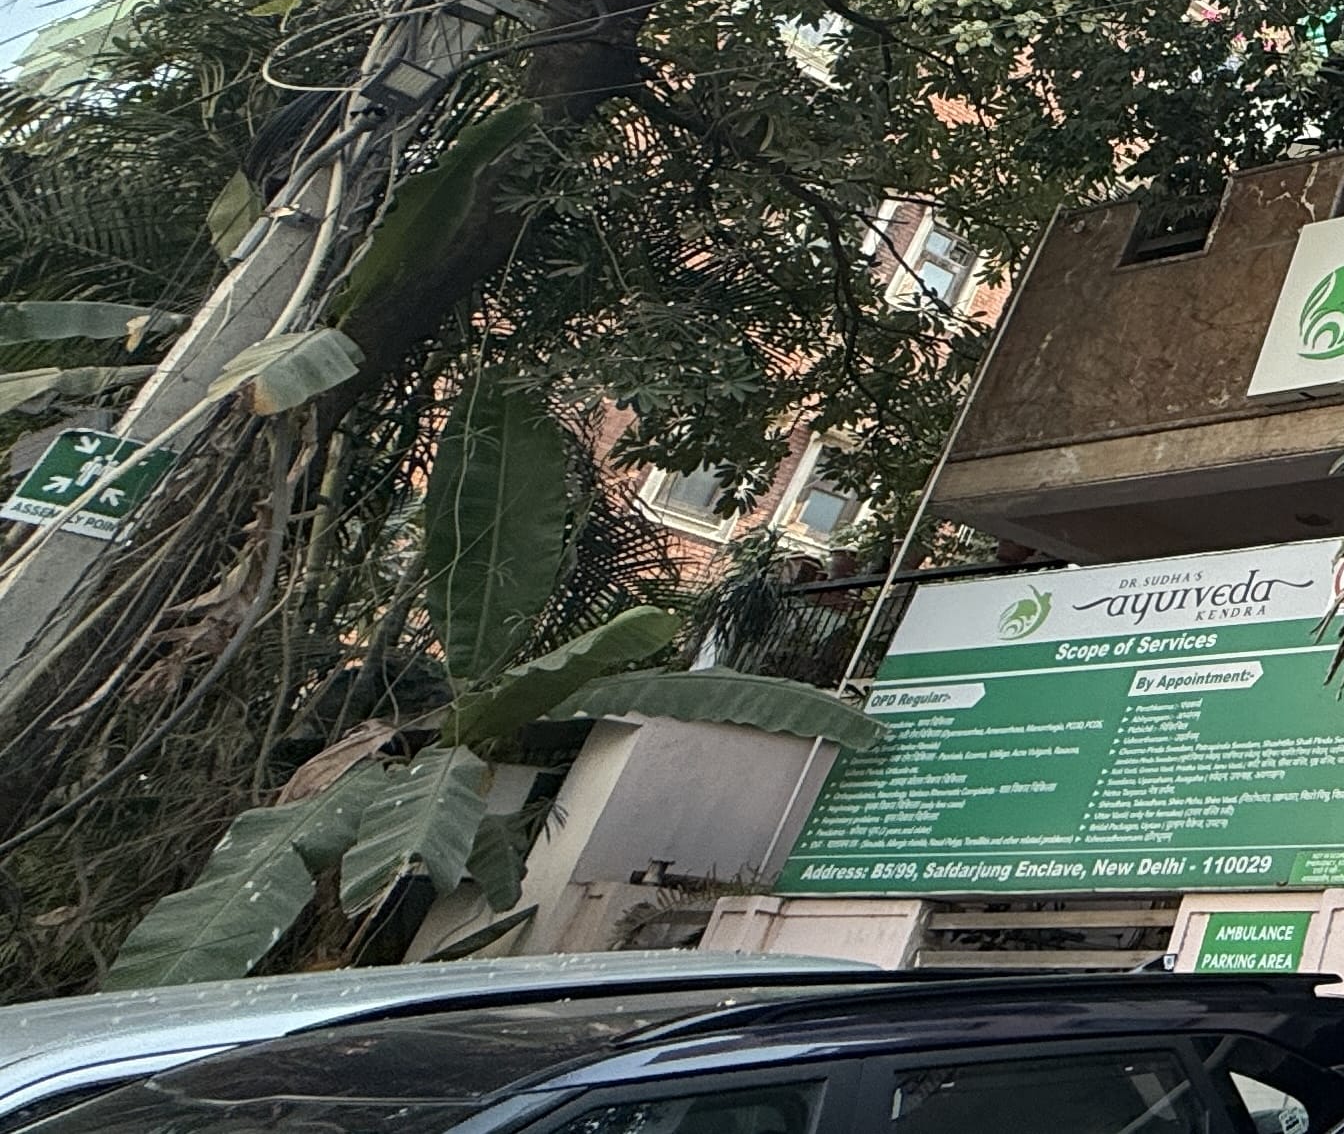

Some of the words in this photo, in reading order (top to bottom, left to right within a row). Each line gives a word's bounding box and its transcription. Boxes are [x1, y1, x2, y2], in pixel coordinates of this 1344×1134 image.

[84, 516, 118, 533] POIN
[1118, 578, 1138, 590] DR
[1143, 570, 1204, 587] SUDHA'S
[1072, 569, 1314, 626] ayurveda
[1195, 604, 1266, 622] KENDRA
[1055, 642, 1111, 662] Scope
[1113, 637, 1137, 656] of
[1137, 632, 1219, 654] Services
[1135, 676, 1155, 693] By
[870, 693, 897, 707] OPD
[800, 863, 869, 880] Address:
[870, 862, 919, 882] B5/99,
[923, 860, 1013, 882] Safdarjung
[1015, 859, 1087, 880] Enclave,
[1092, 858, 1135, 876] New
[1136, 857, 1188, 875] Delhi
[1202, 855, 1273, 874] 110029
[1215, 925, 1295, 941] AMBULANCE
[1201, 953, 1257, 969] PARKING
[1257, 953, 1293, 969] AREA
